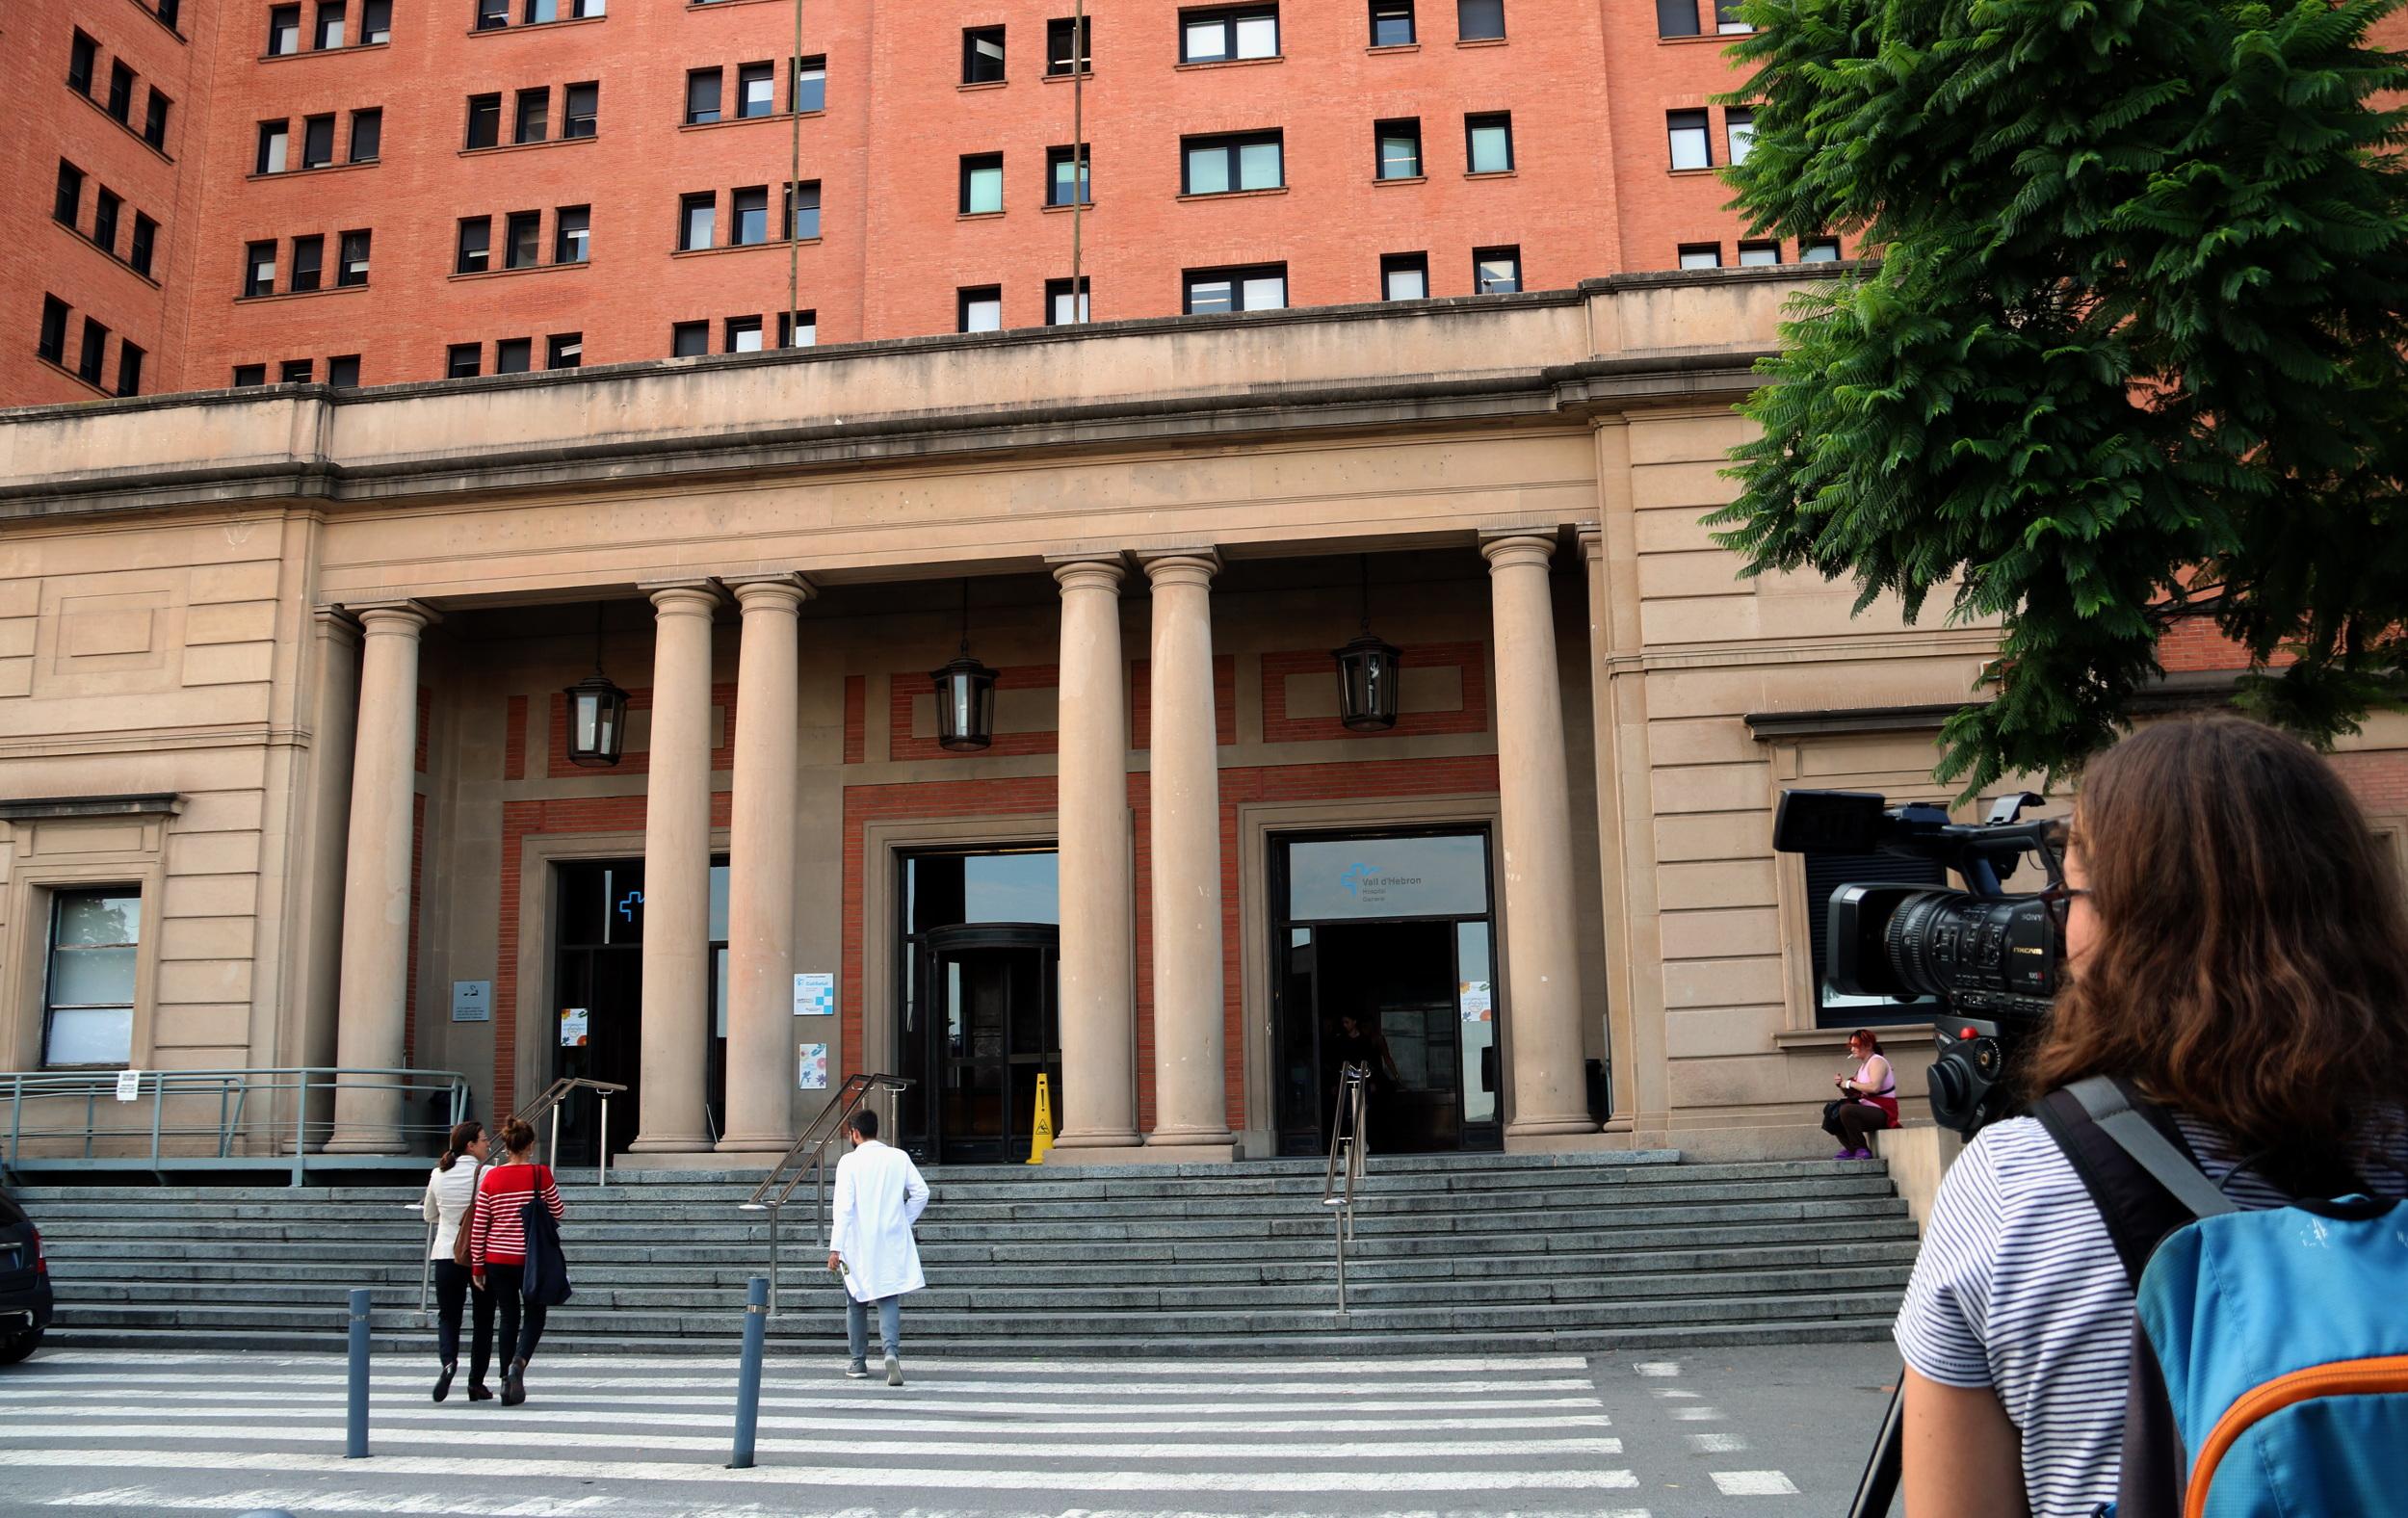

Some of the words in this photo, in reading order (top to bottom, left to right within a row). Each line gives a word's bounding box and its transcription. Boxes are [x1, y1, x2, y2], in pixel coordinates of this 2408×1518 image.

[1362, 877, 1378, 886] Vall
[1380, 877, 1422, 886] d'Hebron
[2022, 913, 2043, 922] SONY
